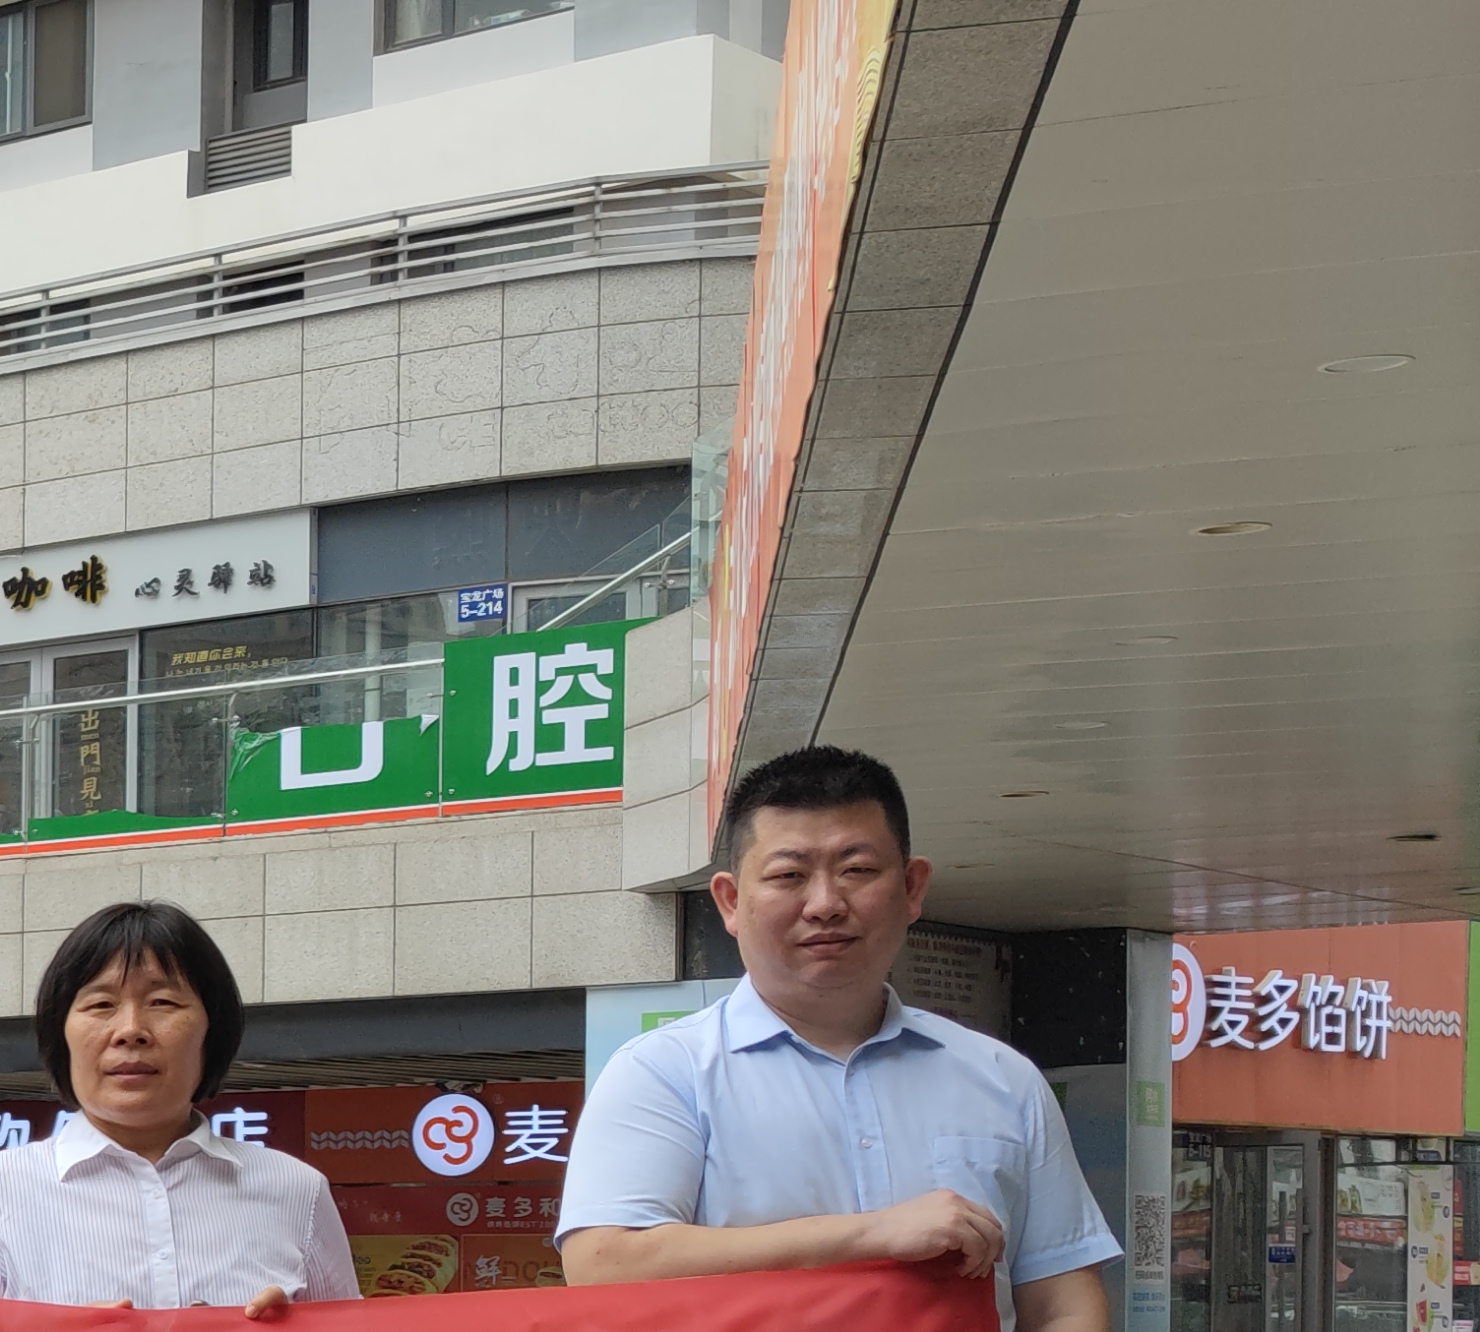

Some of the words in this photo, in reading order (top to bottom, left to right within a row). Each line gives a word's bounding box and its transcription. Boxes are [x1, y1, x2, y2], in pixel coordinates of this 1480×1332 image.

[460, 600, 504, 619] 5-214
[1204, 966, 1393, 1061] 麦多馅饼
